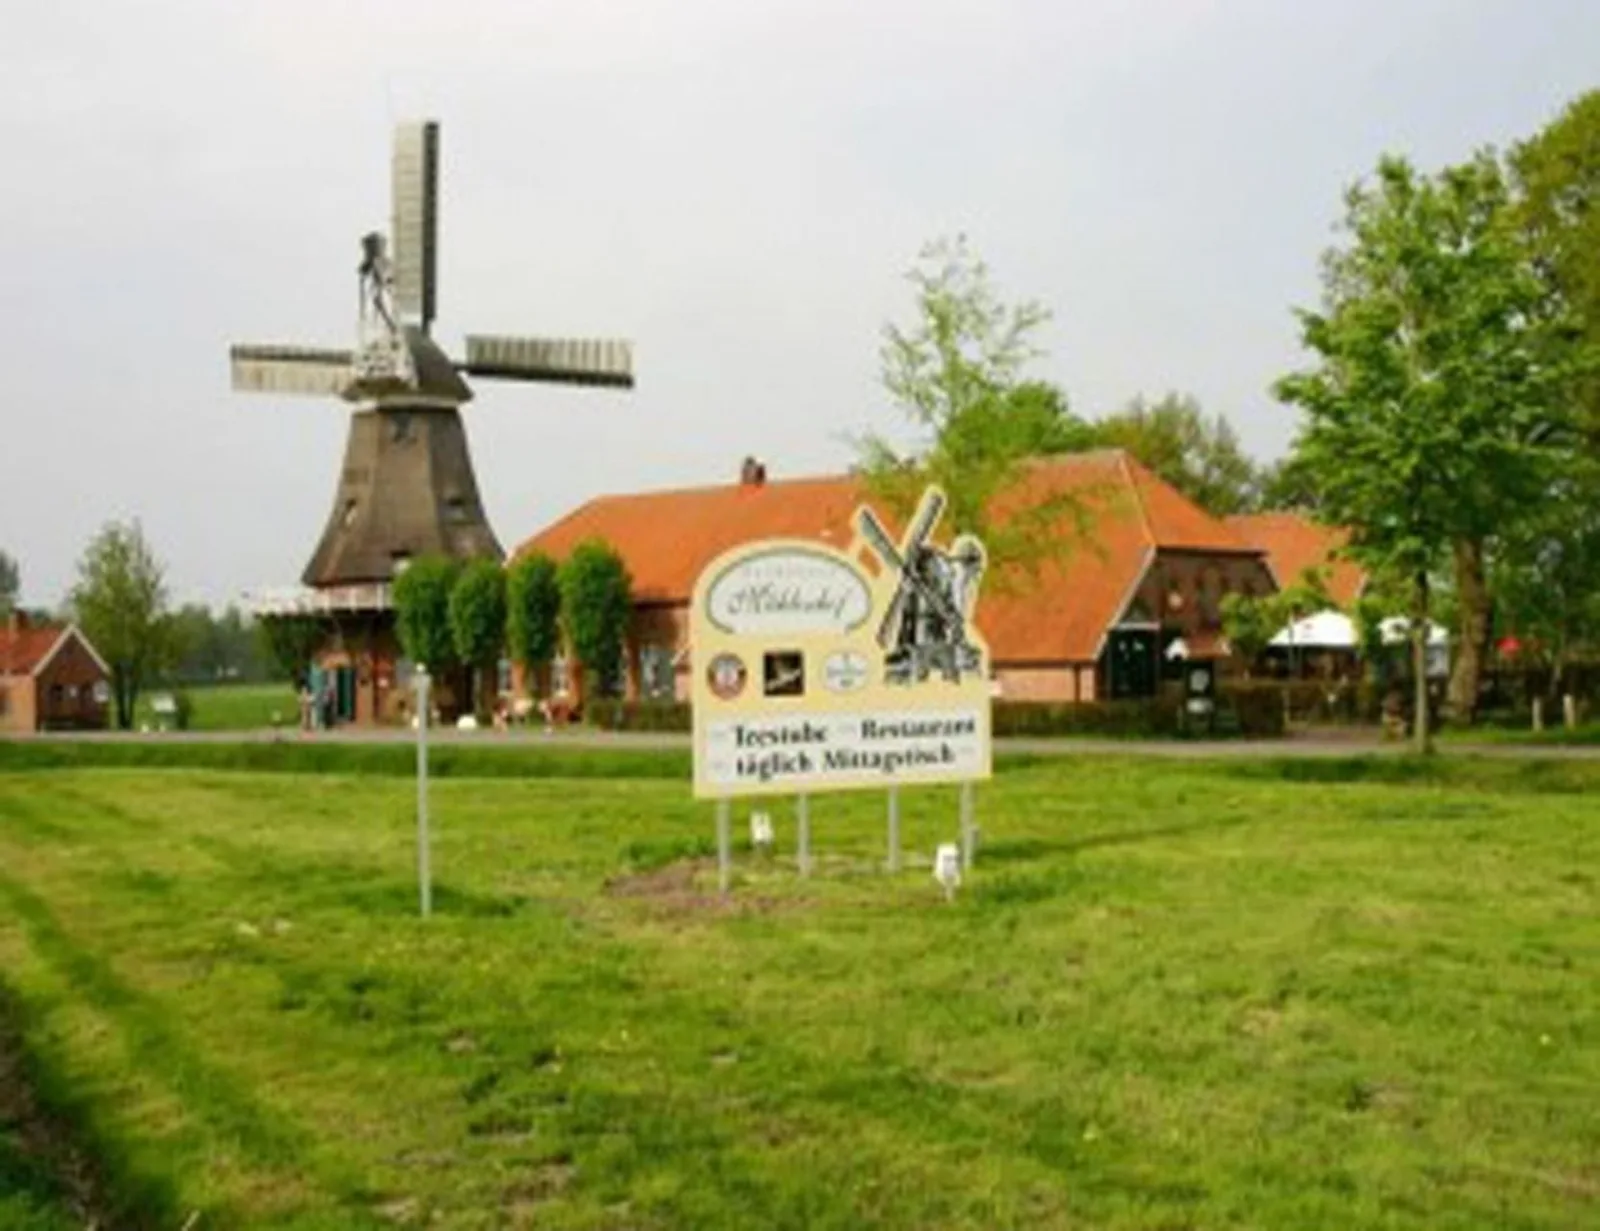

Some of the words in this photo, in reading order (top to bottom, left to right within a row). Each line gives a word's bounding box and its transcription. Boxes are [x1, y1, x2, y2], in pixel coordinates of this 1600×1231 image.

[733, 721, 827, 747] Teestube
[860, 717, 974, 740] Restaurant
[736, 751, 812, 781] täglich
[822, 744, 955, 774] Mittagstisch
